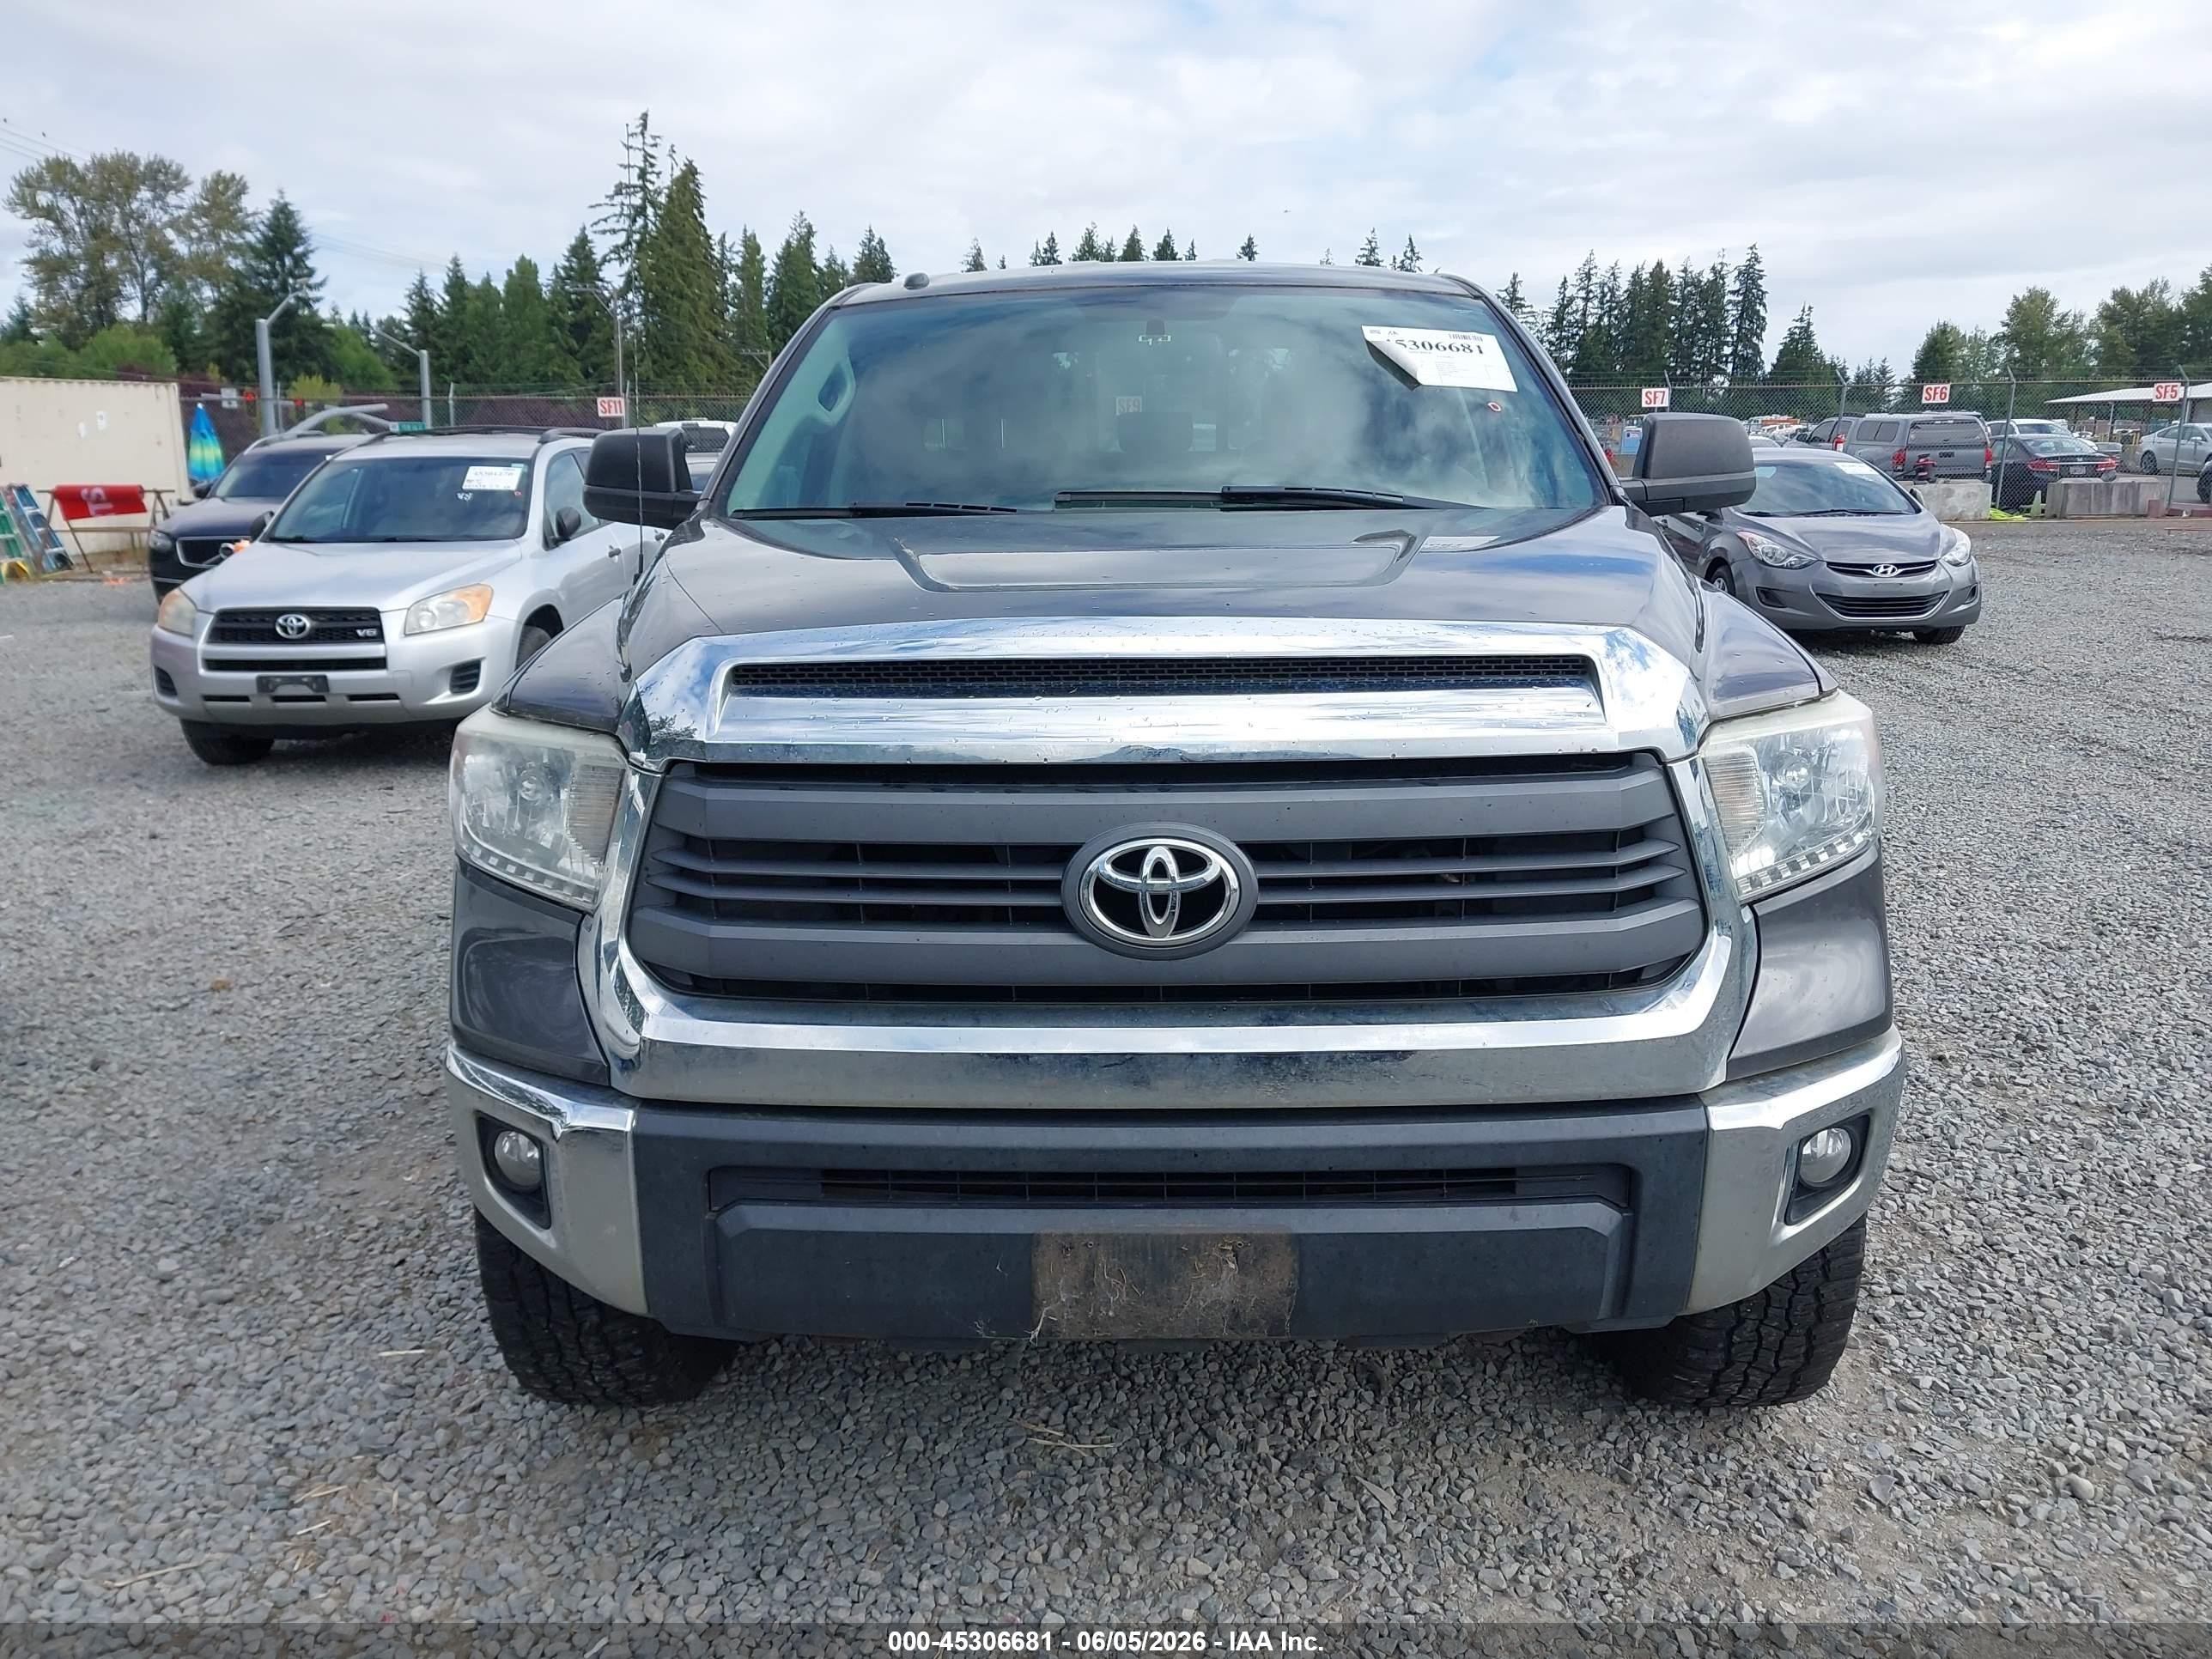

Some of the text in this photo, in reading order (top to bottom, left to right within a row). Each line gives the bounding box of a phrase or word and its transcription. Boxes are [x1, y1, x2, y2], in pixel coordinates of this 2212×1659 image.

[1386, 338, 1484, 354] 5306681
[1644, 390, 1666, 404] SF7
[1923, 386, 1948, 401] SF6
[2155, 384, 2179, 399] SF5
[599, 399, 623, 414] SF11
[356, 628, 378, 637] V6
